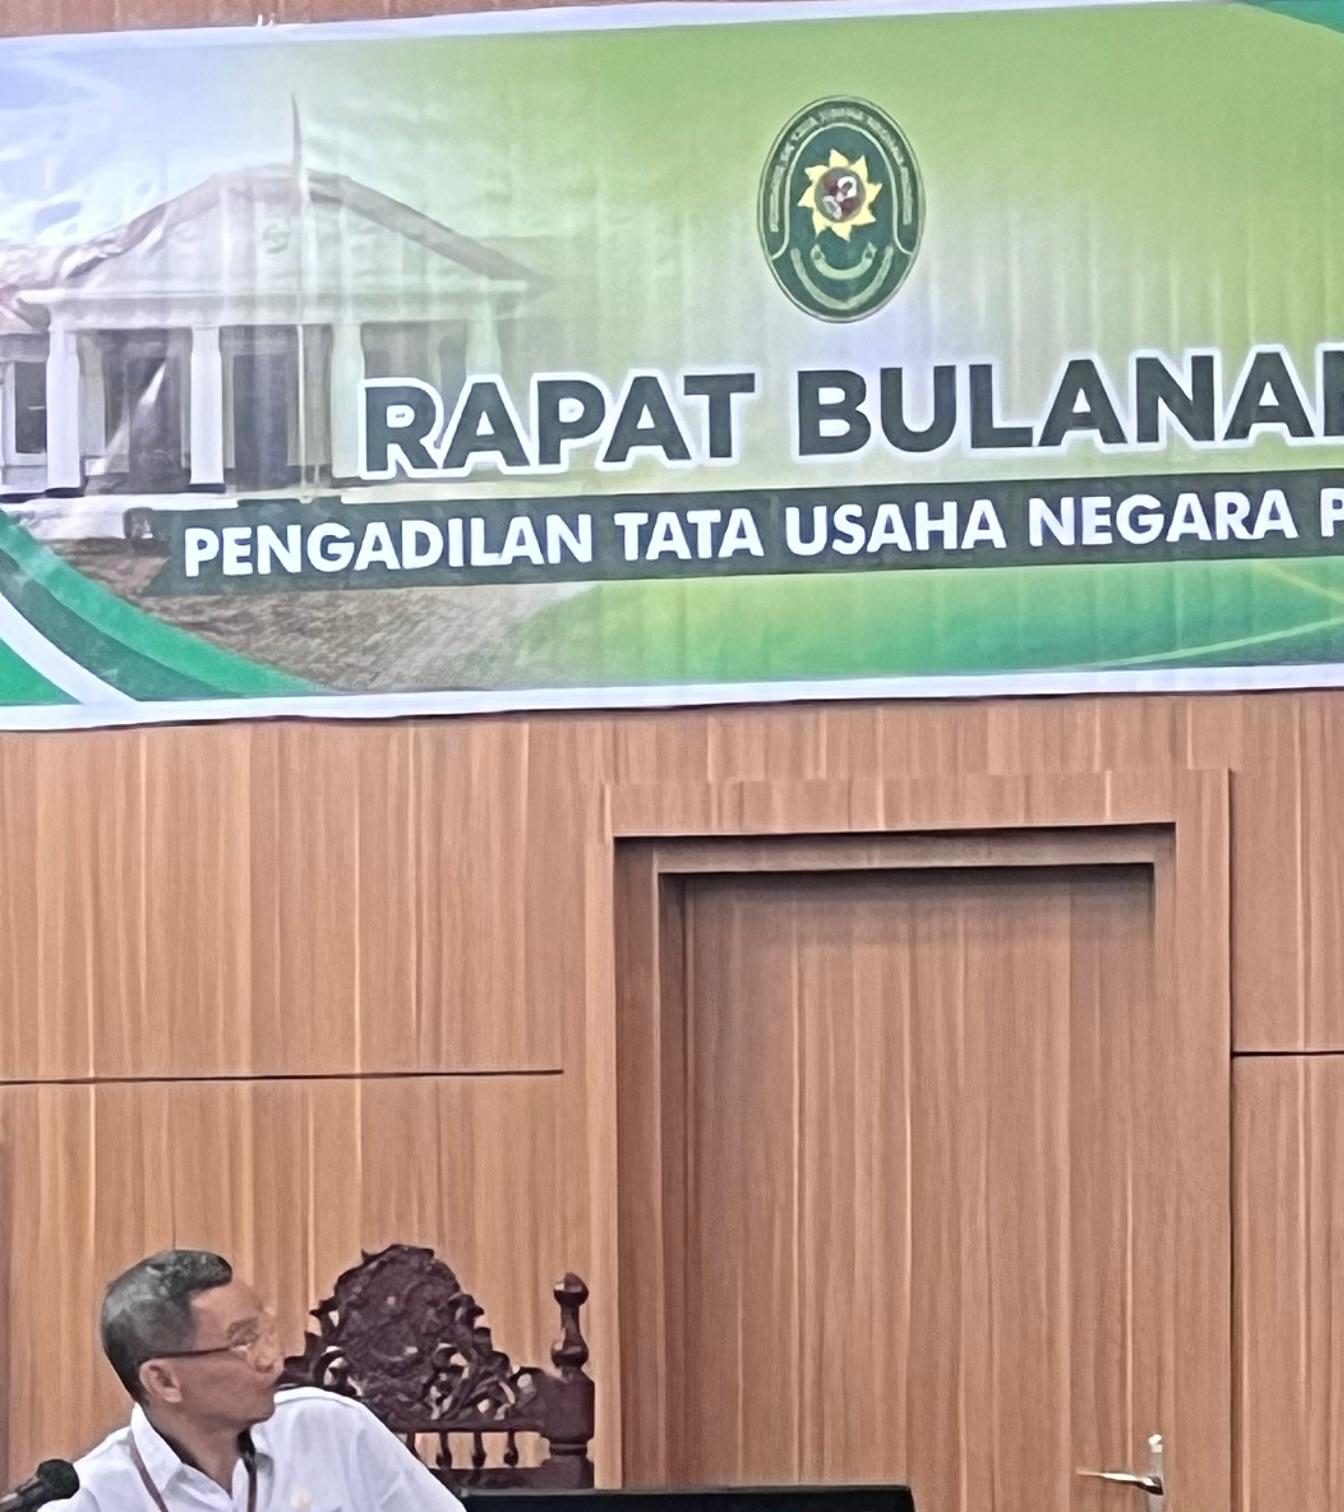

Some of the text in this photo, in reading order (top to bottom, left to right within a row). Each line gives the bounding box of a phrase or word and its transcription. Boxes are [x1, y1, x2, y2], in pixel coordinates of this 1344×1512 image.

[364, 371, 756, 473] RAPAT
[183, 514, 593, 577] PENGADILAN
[614, 507, 765, 562] TATA
[784, 499, 1006, 556] USAHA
[1028, 490, 1299, 547] NEGARA
